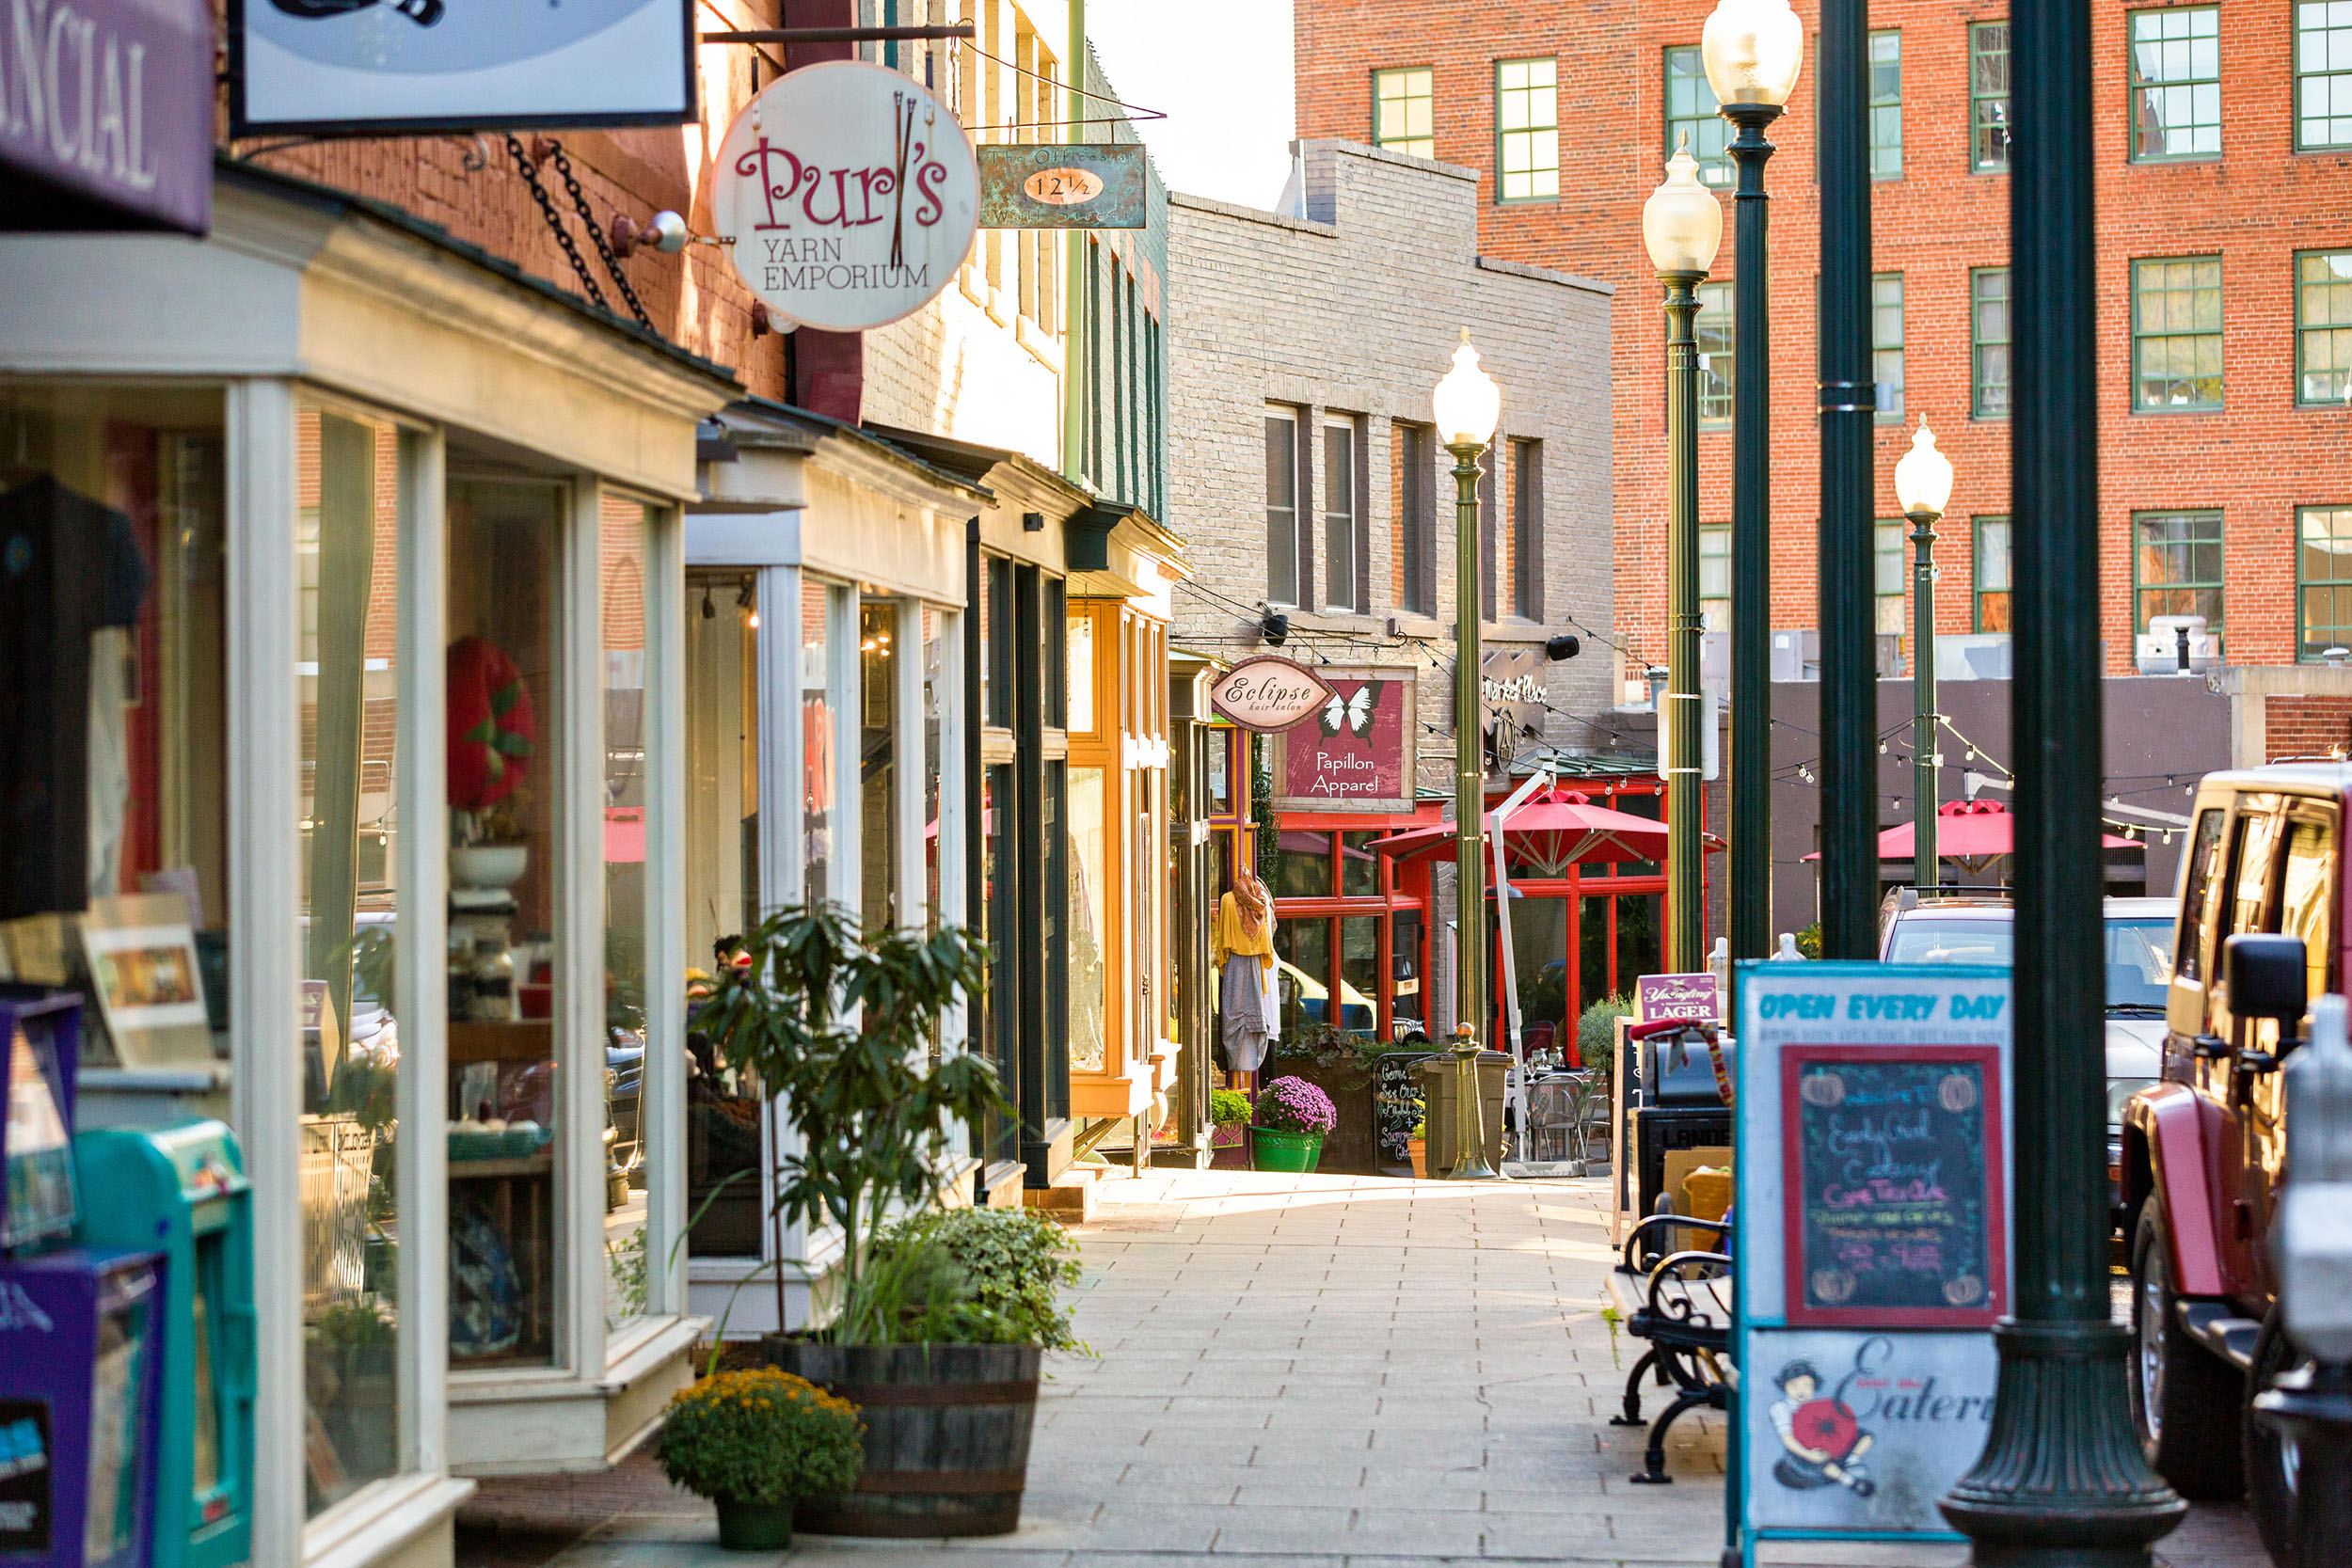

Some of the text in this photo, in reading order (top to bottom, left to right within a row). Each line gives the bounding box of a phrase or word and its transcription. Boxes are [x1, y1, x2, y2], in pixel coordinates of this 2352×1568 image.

[0, 0, 158, 191] NCIAL
[1035, 149, 1107, 165] Offices
[993, 210, 1134, 222] Wall Street
[763, 237, 843, 263] YARN
[763, 264, 930, 292] EMPORIUM
[1225, 677, 1311, 707] Eclipse
[1248, 702, 1302, 711] hair salon
[1317, 752, 1375, 777] Papillon
[1311, 775, 1379, 799] Apparel
[1649, 1005, 1712, 1020] LAGER
[1759, 993, 2006, 1021] OPEN EVERY DAY
